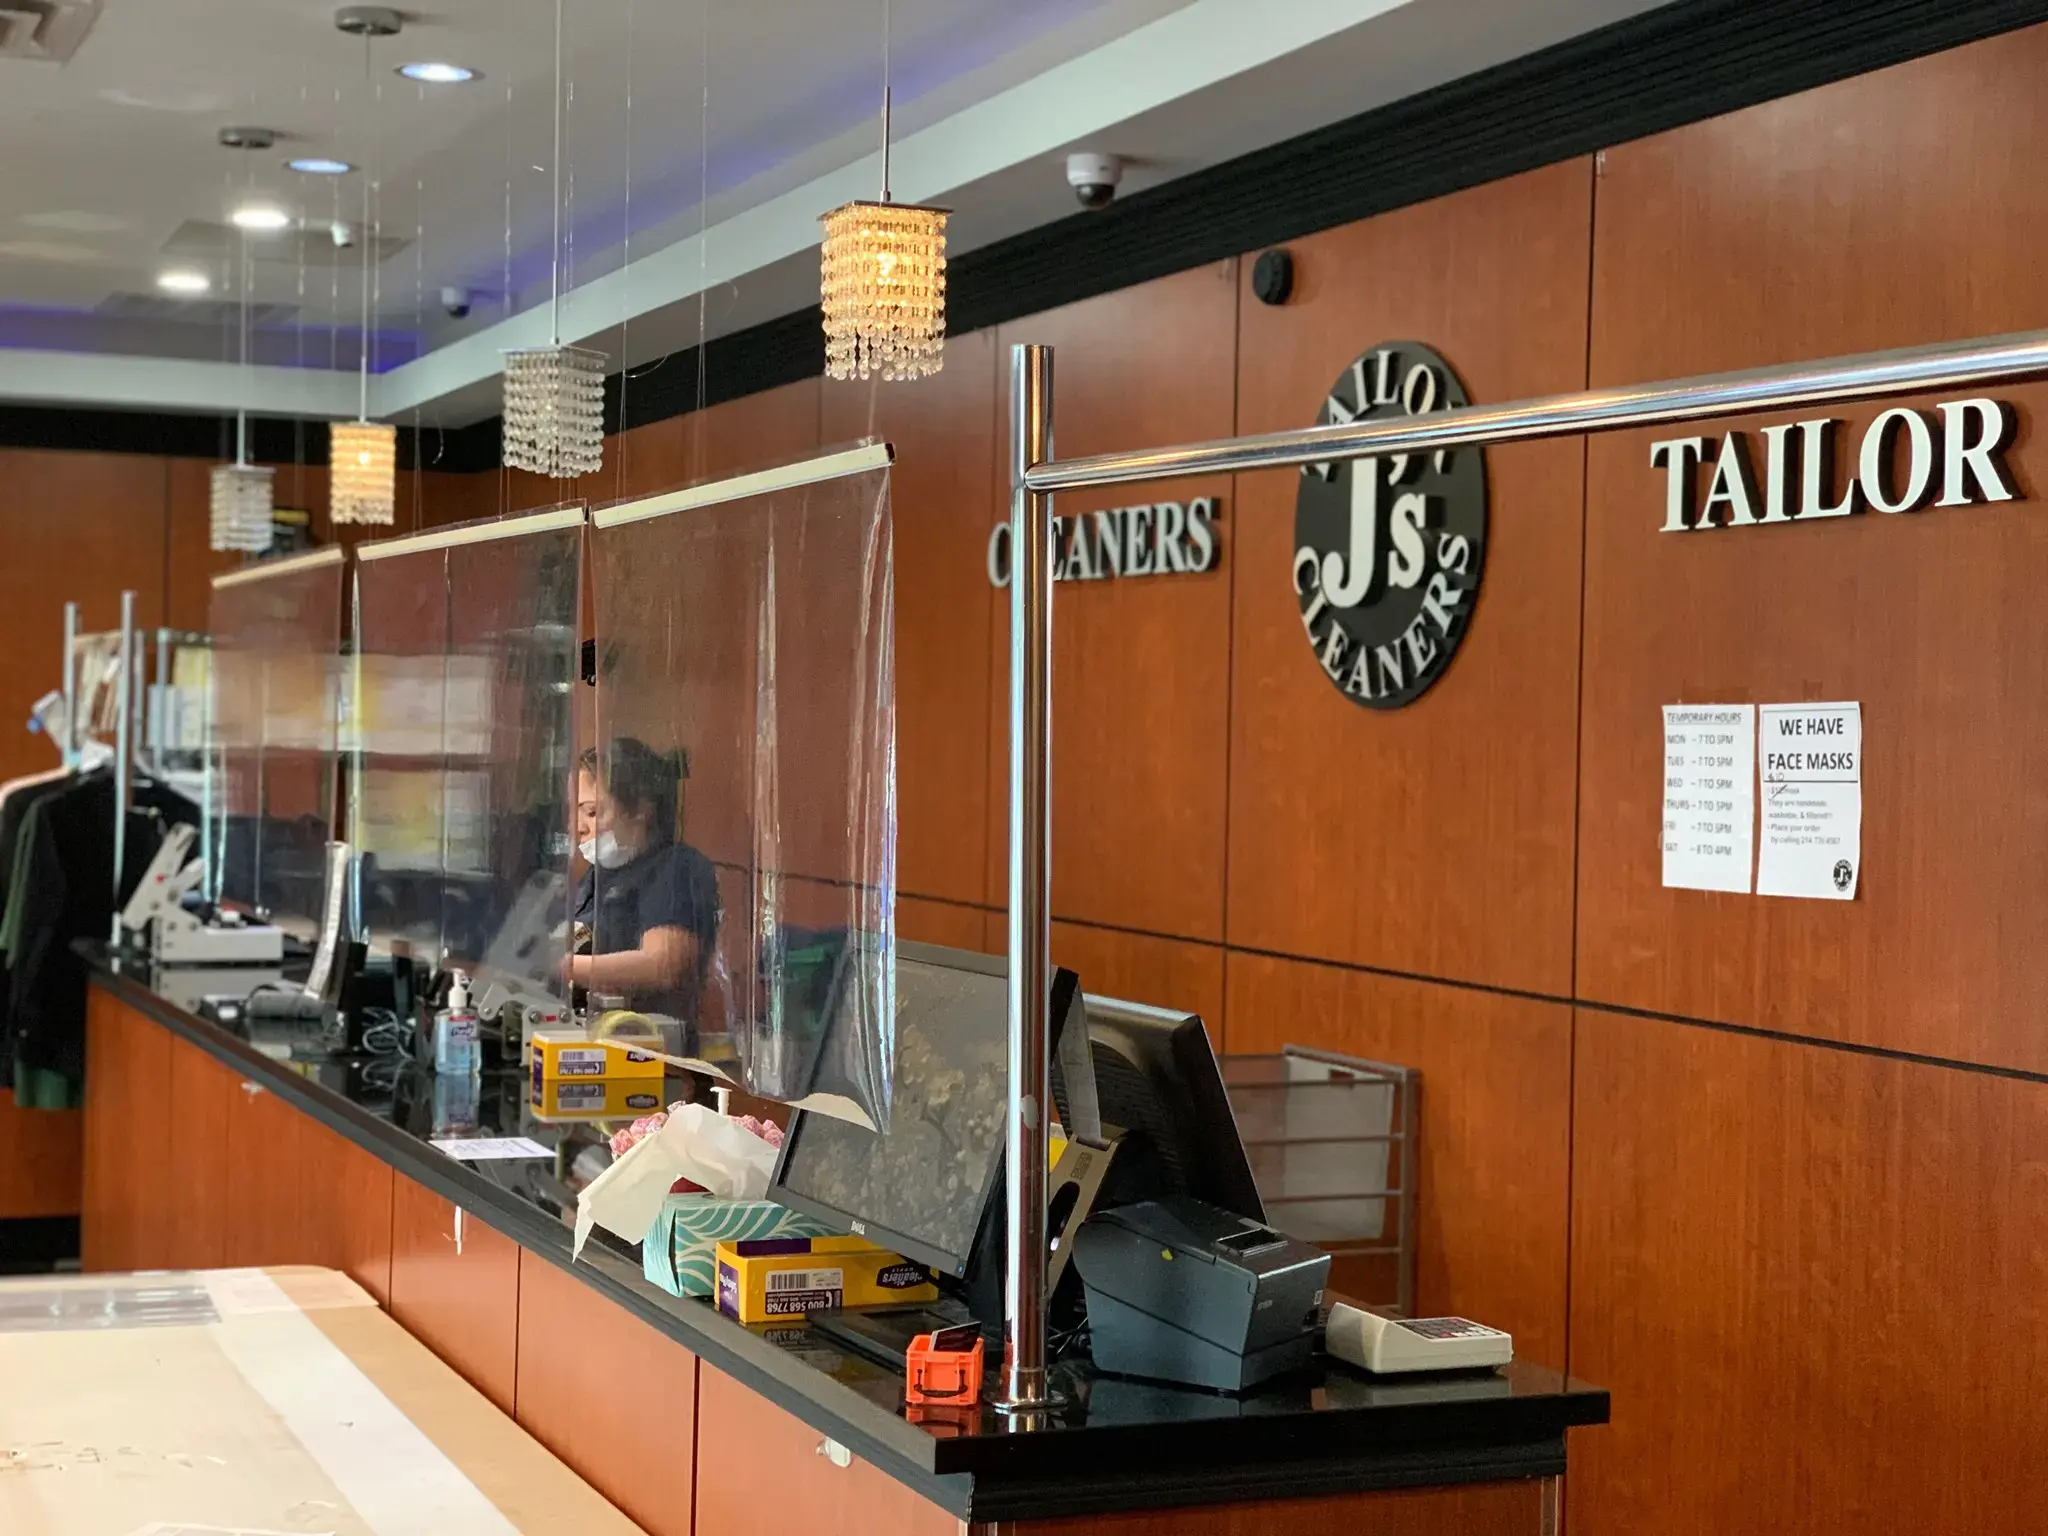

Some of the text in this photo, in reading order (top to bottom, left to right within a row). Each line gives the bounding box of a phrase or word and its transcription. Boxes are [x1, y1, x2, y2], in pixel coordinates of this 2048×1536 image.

[1301, 350, 1452, 482] AILO
[1650, 398, 2013, 533] TAILOR
[987, 497, 1214, 588] CANERS
[1293, 532, 1470, 700] CLEANERS
[1714, 712, 1742, 723] HOURS
[1779, 718, 1844, 735] WE HAVE
[1768, 752, 1853, 770] FACE MASKS
[766, 1302, 788, 1314] 7768
[789, 1301, 806, 1312] 568
